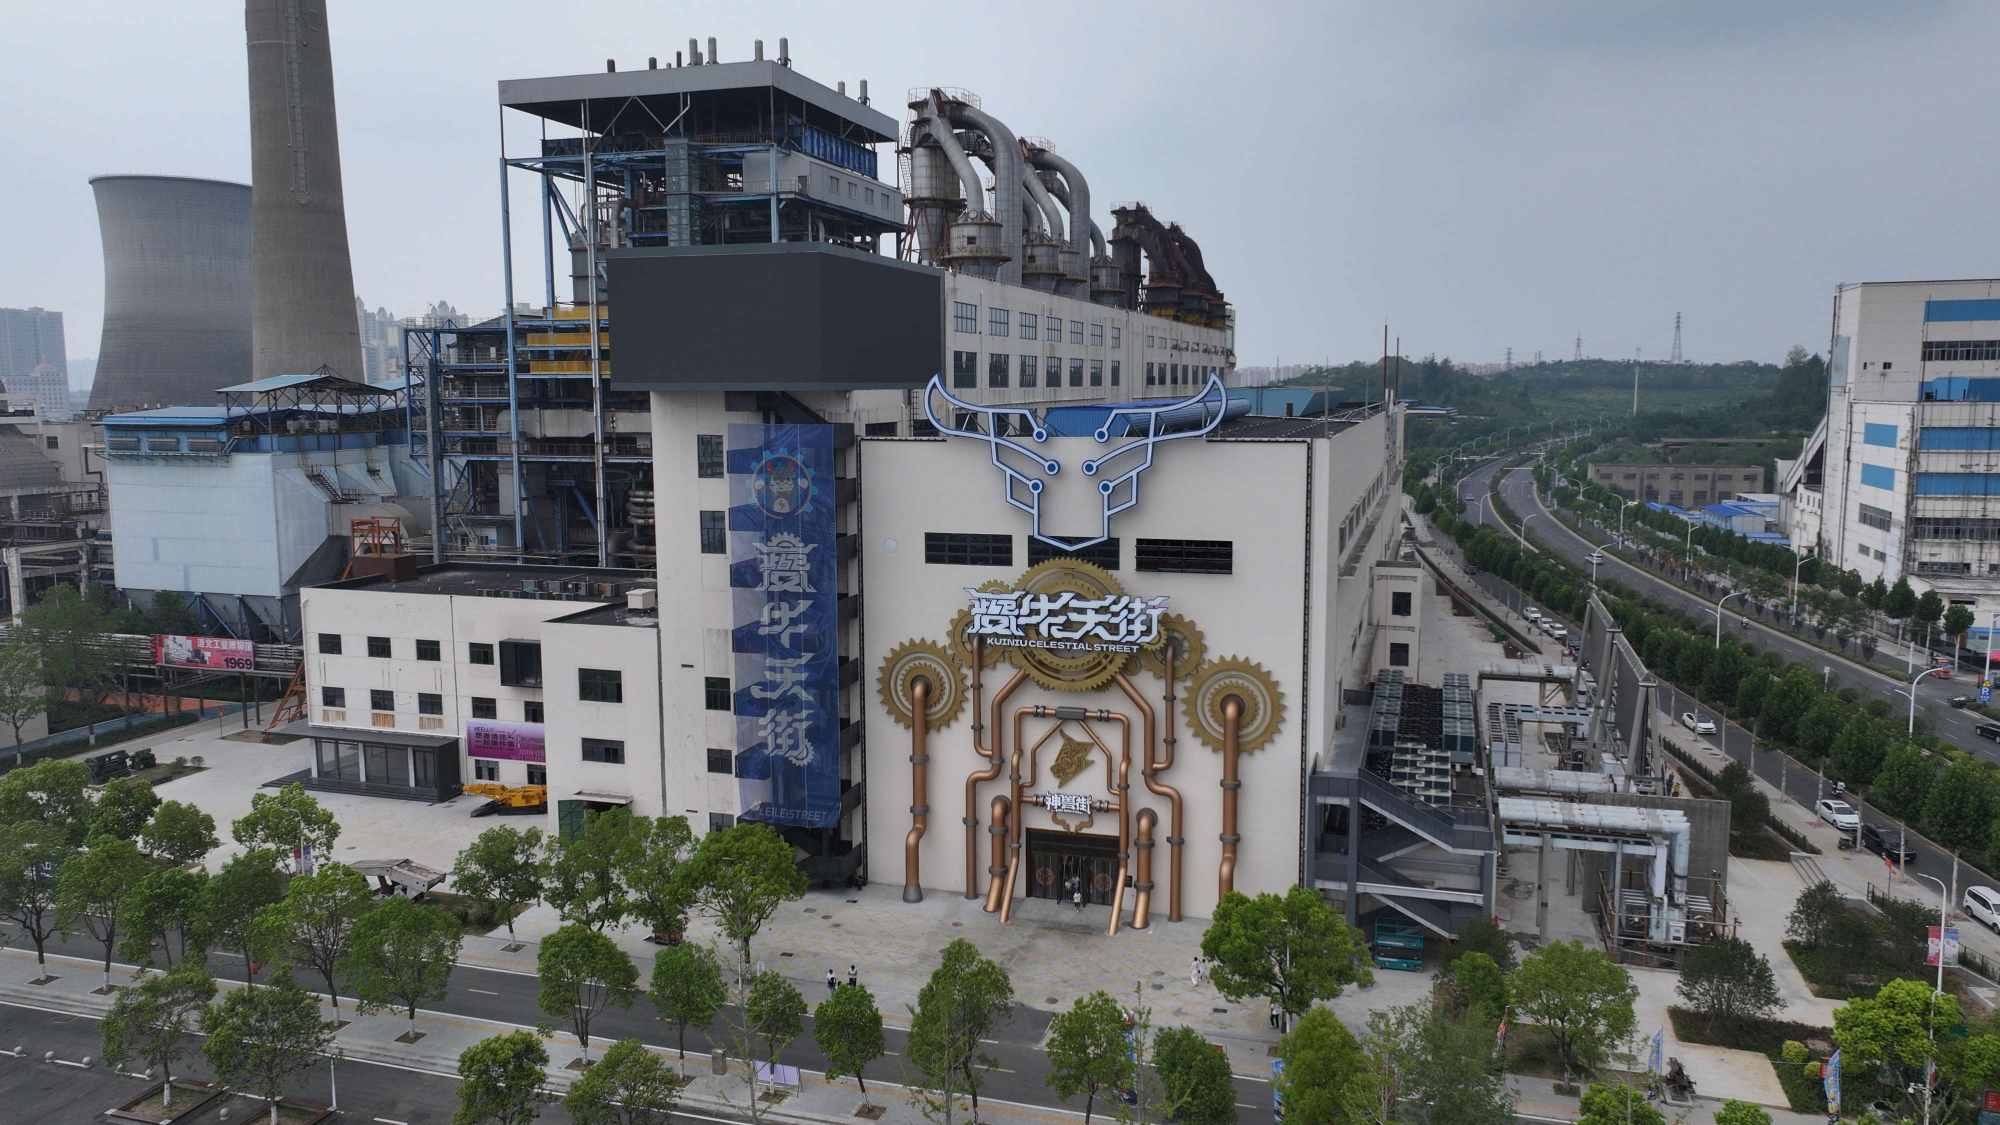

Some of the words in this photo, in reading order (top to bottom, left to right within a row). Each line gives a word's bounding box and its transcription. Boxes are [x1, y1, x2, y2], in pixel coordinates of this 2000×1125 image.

[965, 588, 1170, 644] 夔牛天街
[987, 638, 1028, 647] KUINIU
[1029, 639, 1092, 651] CELESTIAL
[1094, 643, 1139, 653] STREET
[224, 657, 252, 670] 1969
